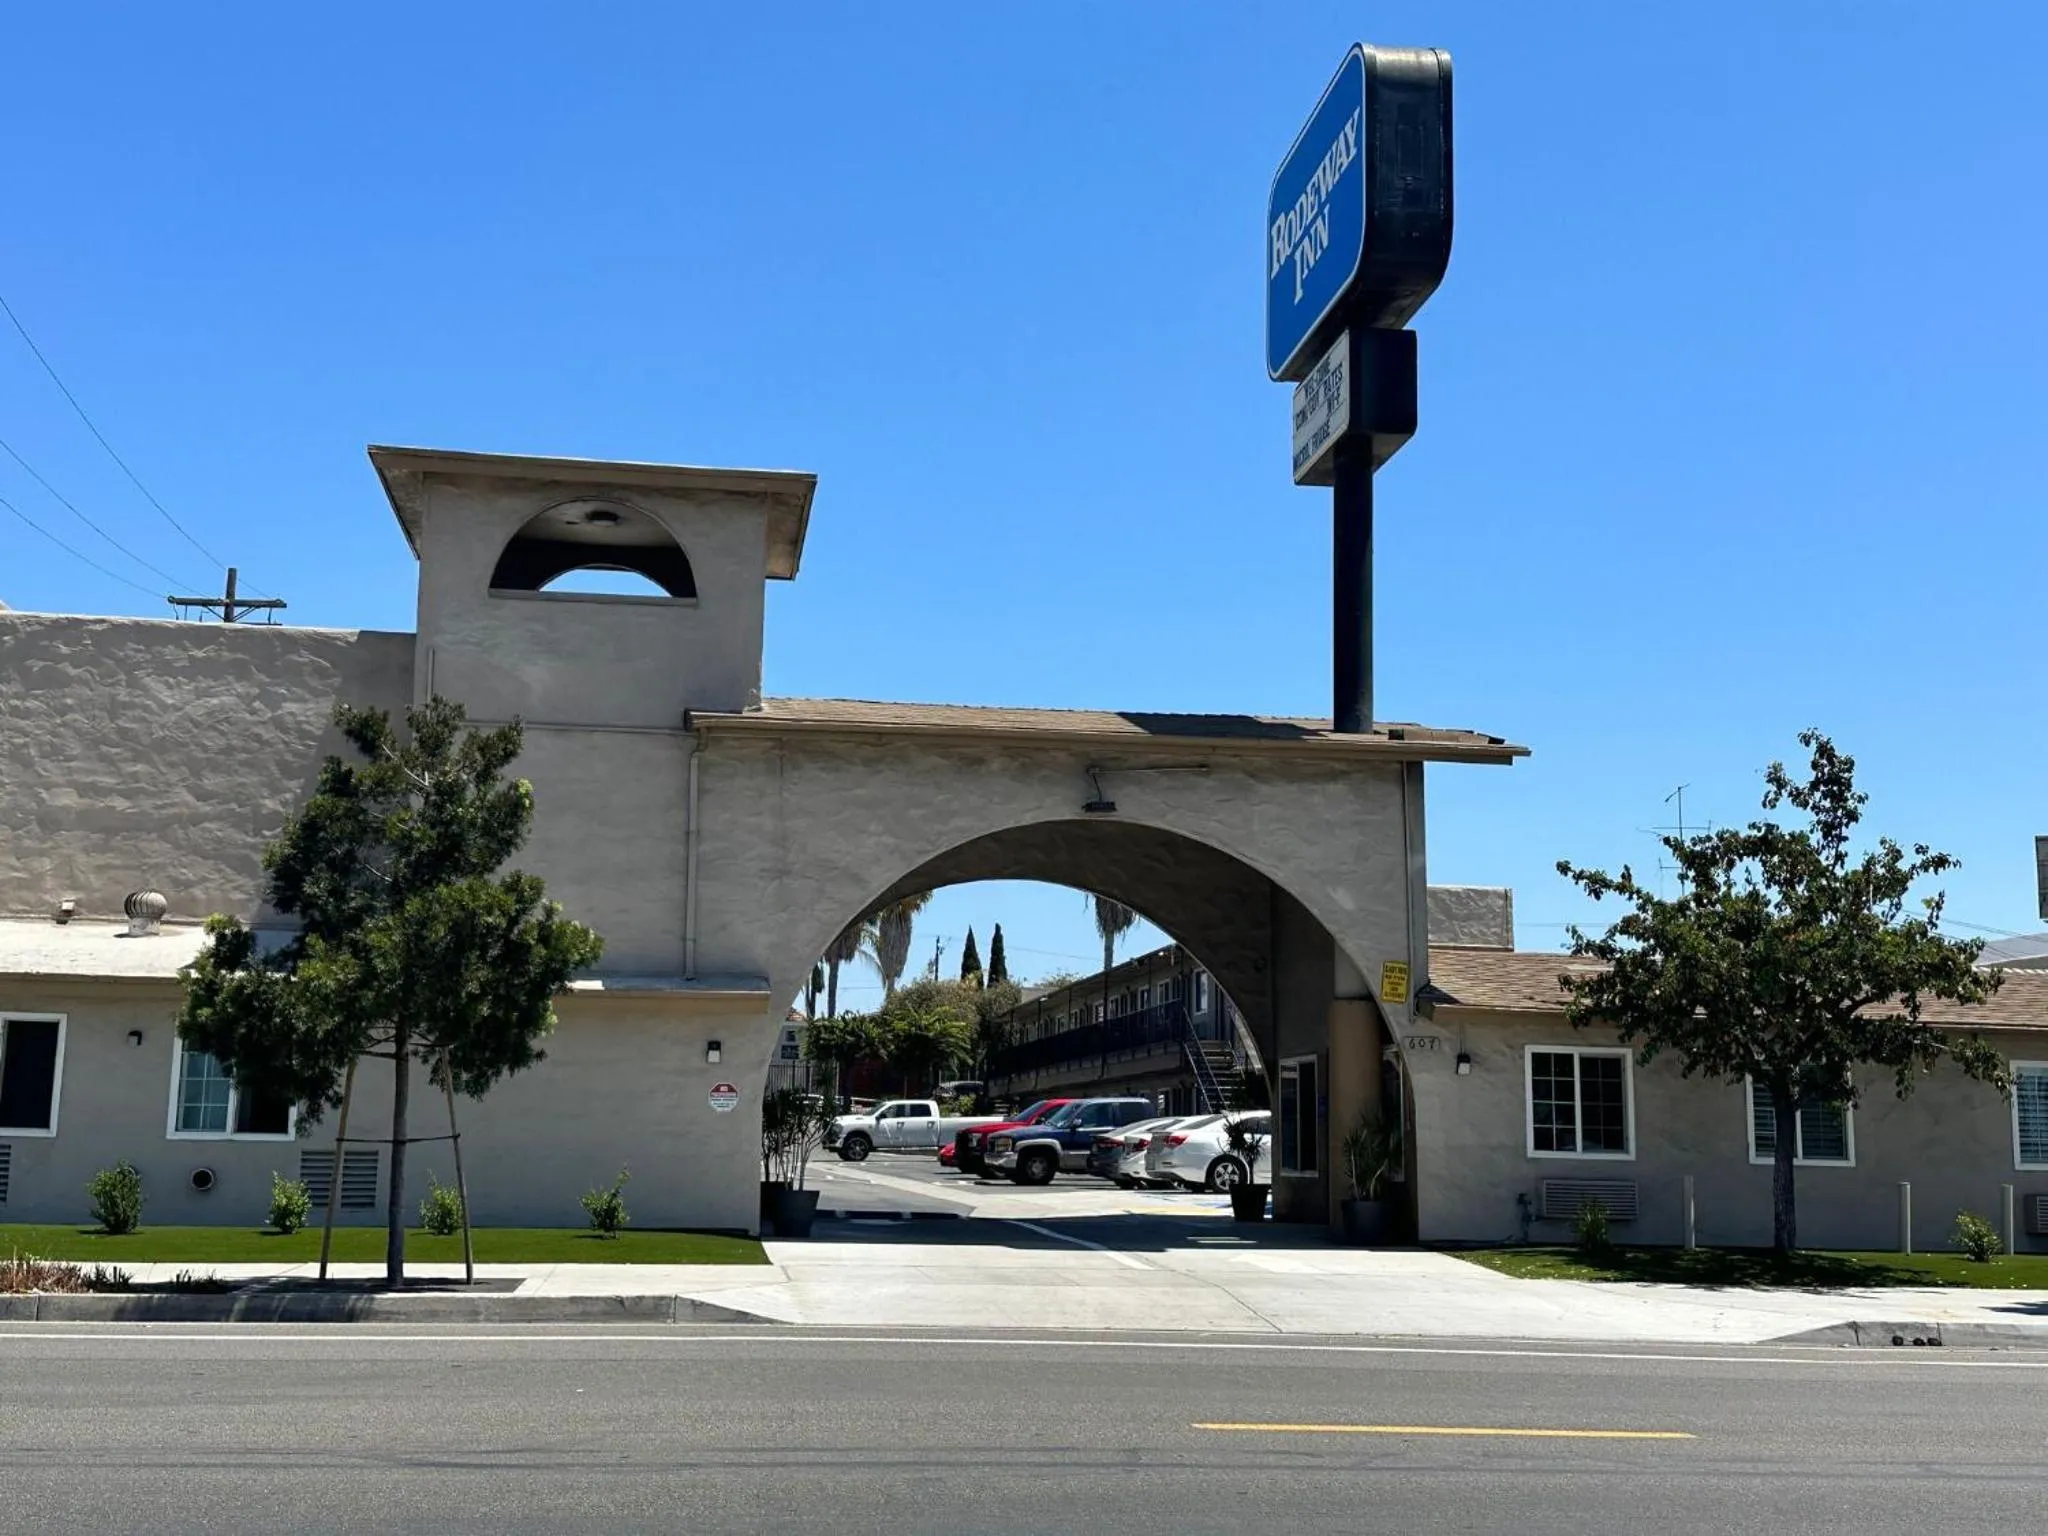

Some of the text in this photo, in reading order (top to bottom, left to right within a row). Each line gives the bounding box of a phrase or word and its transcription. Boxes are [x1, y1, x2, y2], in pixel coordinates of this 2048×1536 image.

[1271, 106, 1361, 281] RODEWAY
[1294, 203, 1330, 305] INN
[1409, 1038, 1436, 1051] 607
